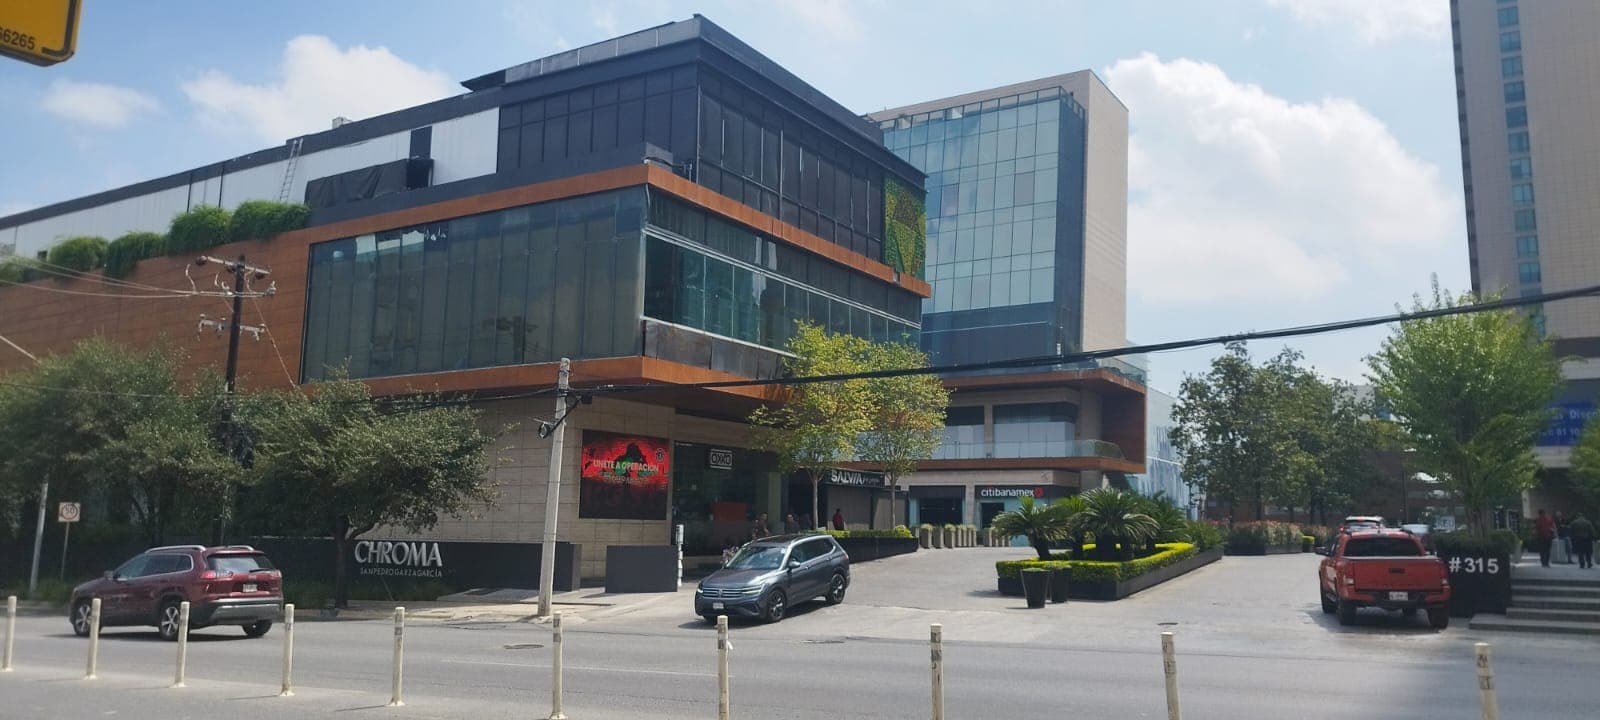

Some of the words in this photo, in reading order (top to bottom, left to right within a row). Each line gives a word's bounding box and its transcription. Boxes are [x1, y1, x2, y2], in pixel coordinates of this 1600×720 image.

[831, 469, 863, 485] SALVIA
[981, 487, 1034, 497] citibanamex
[355, 540, 443, 567] CHROMA
[1448, 557, 1499, 574] #315
